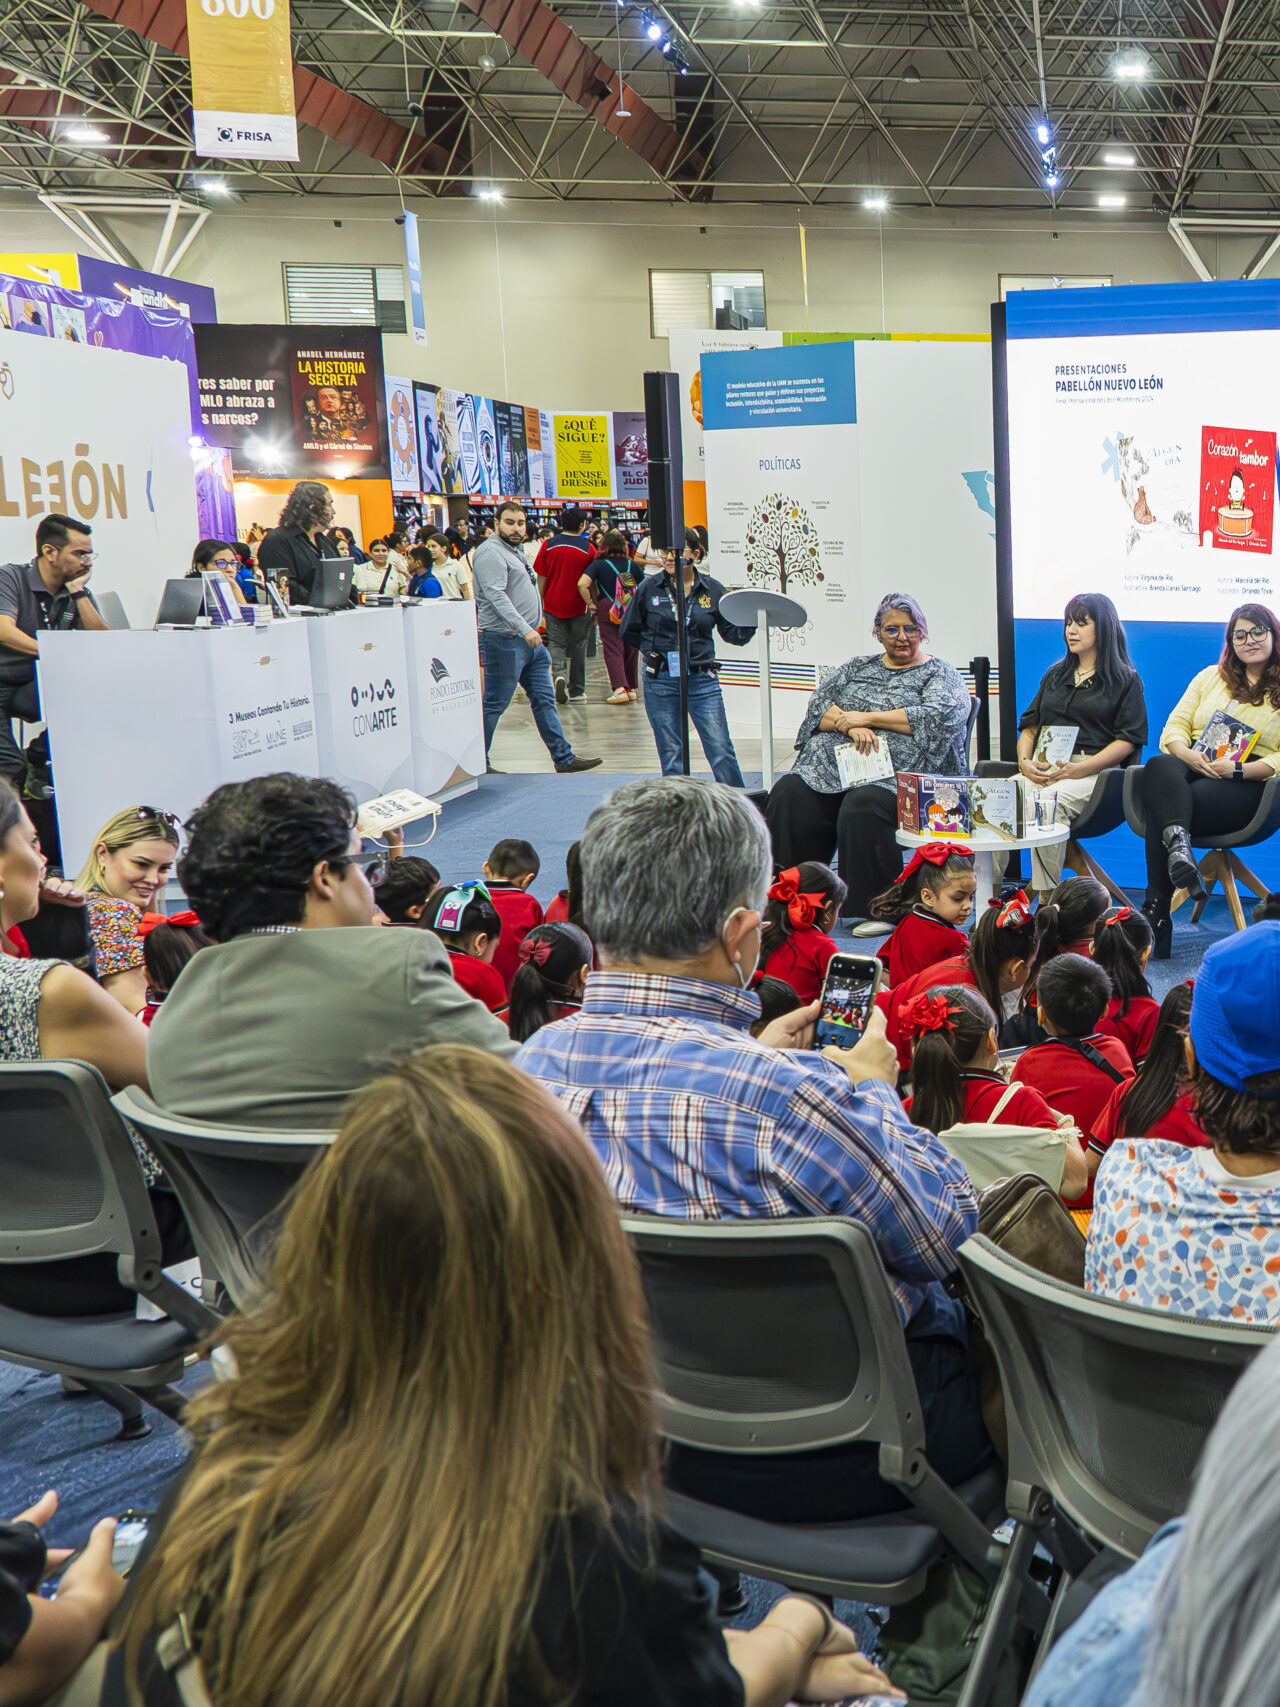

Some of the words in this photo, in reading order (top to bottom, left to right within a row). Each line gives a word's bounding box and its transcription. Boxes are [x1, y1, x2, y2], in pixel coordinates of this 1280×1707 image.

[236, 131, 272, 142] FRISA
[298, 360, 312, 373] LA
[314, 361, 366, 374] HISTORIA
[1055, 363, 1127, 376] PRESENTACIONES
[218, 377, 252, 390] saber
[255, 379, 275, 392] por
[308, 373, 358, 386] SECRETA
[1055, 376, 1102, 392] PABELLÓN
[1104, 378, 1137, 391] NUEVO
[1138, 374, 1164, 390] LEÓN
[226, 395, 265, 408] abraza
[267, 396, 275, 408] a
[211, 412, 259, 425] narcos?
[563, 417, 597, 431] ¿QUÉ
[557, 432, 606, 443] SIGUE?
[1207, 438, 1239, 456] Corazón
[759, 455, 801, 471] POLÍTICAS
[1239, 449, 1269, 466] tambor
[565, 470, 603, 479] DENISE
[561, 478, 608, 487] DRESSER
[228, 713, 234, 724] 3
[235, 710, 257, 723] Museos
[352, 706, 398, 738] CONARTE
